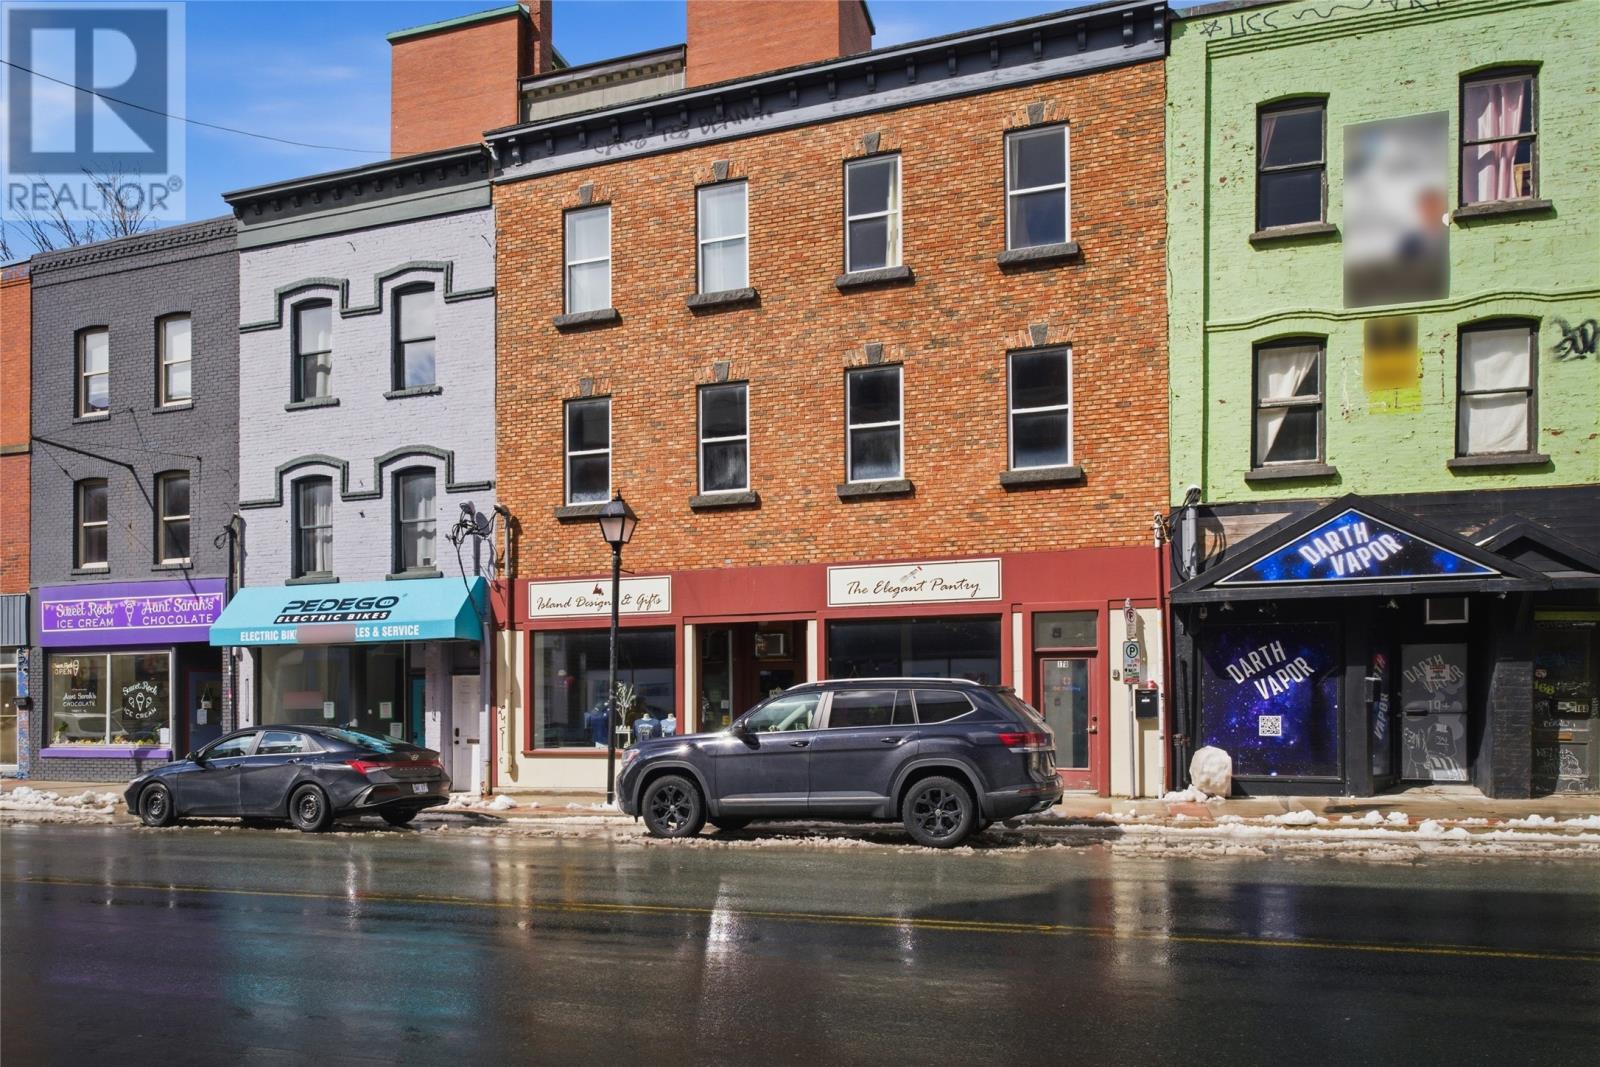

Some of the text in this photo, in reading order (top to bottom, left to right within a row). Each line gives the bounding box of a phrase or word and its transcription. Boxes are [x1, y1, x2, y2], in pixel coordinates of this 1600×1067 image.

[1299, 522, 1370, 565] DARTH
[1330, 533, 1403, 576] VAPOR
[847, 580, 868, 595] The
[873, 580, 927, 598] Elegant
[56, 602, 114, 618] Sweet Rock
[141, 598, 214, 616] Aunt Sarah's
[281, 596, 399, 613] PEDEGO
[537, 596, 572, 611] Island
[621, 594, 631, 606] &
[636, 593, 662, 612] Gifts
[56, 618, 114, 629] ICE CREAM
[142, 613, 213, 625] CHOCOLATE
[276, 611, 388, 623] ELECTRIC BIKES
[240, 630, 280, 642] ELECTRIC
[355, 626, 370, 638] LES
[373, 626, 380, 637] &
[382, 625, 420, 637] SERVICE
[1225, 640, 1287, 685] DARTH
[55, 668, 72, 676] OPEN
[1253, 655, 1316, 701] VAPOR
[62, 700, 96, 708] CHOCOLATE
[1428, 699, 1451, 713] 19+
[124, 707, 157, 719] ICE CREAM
